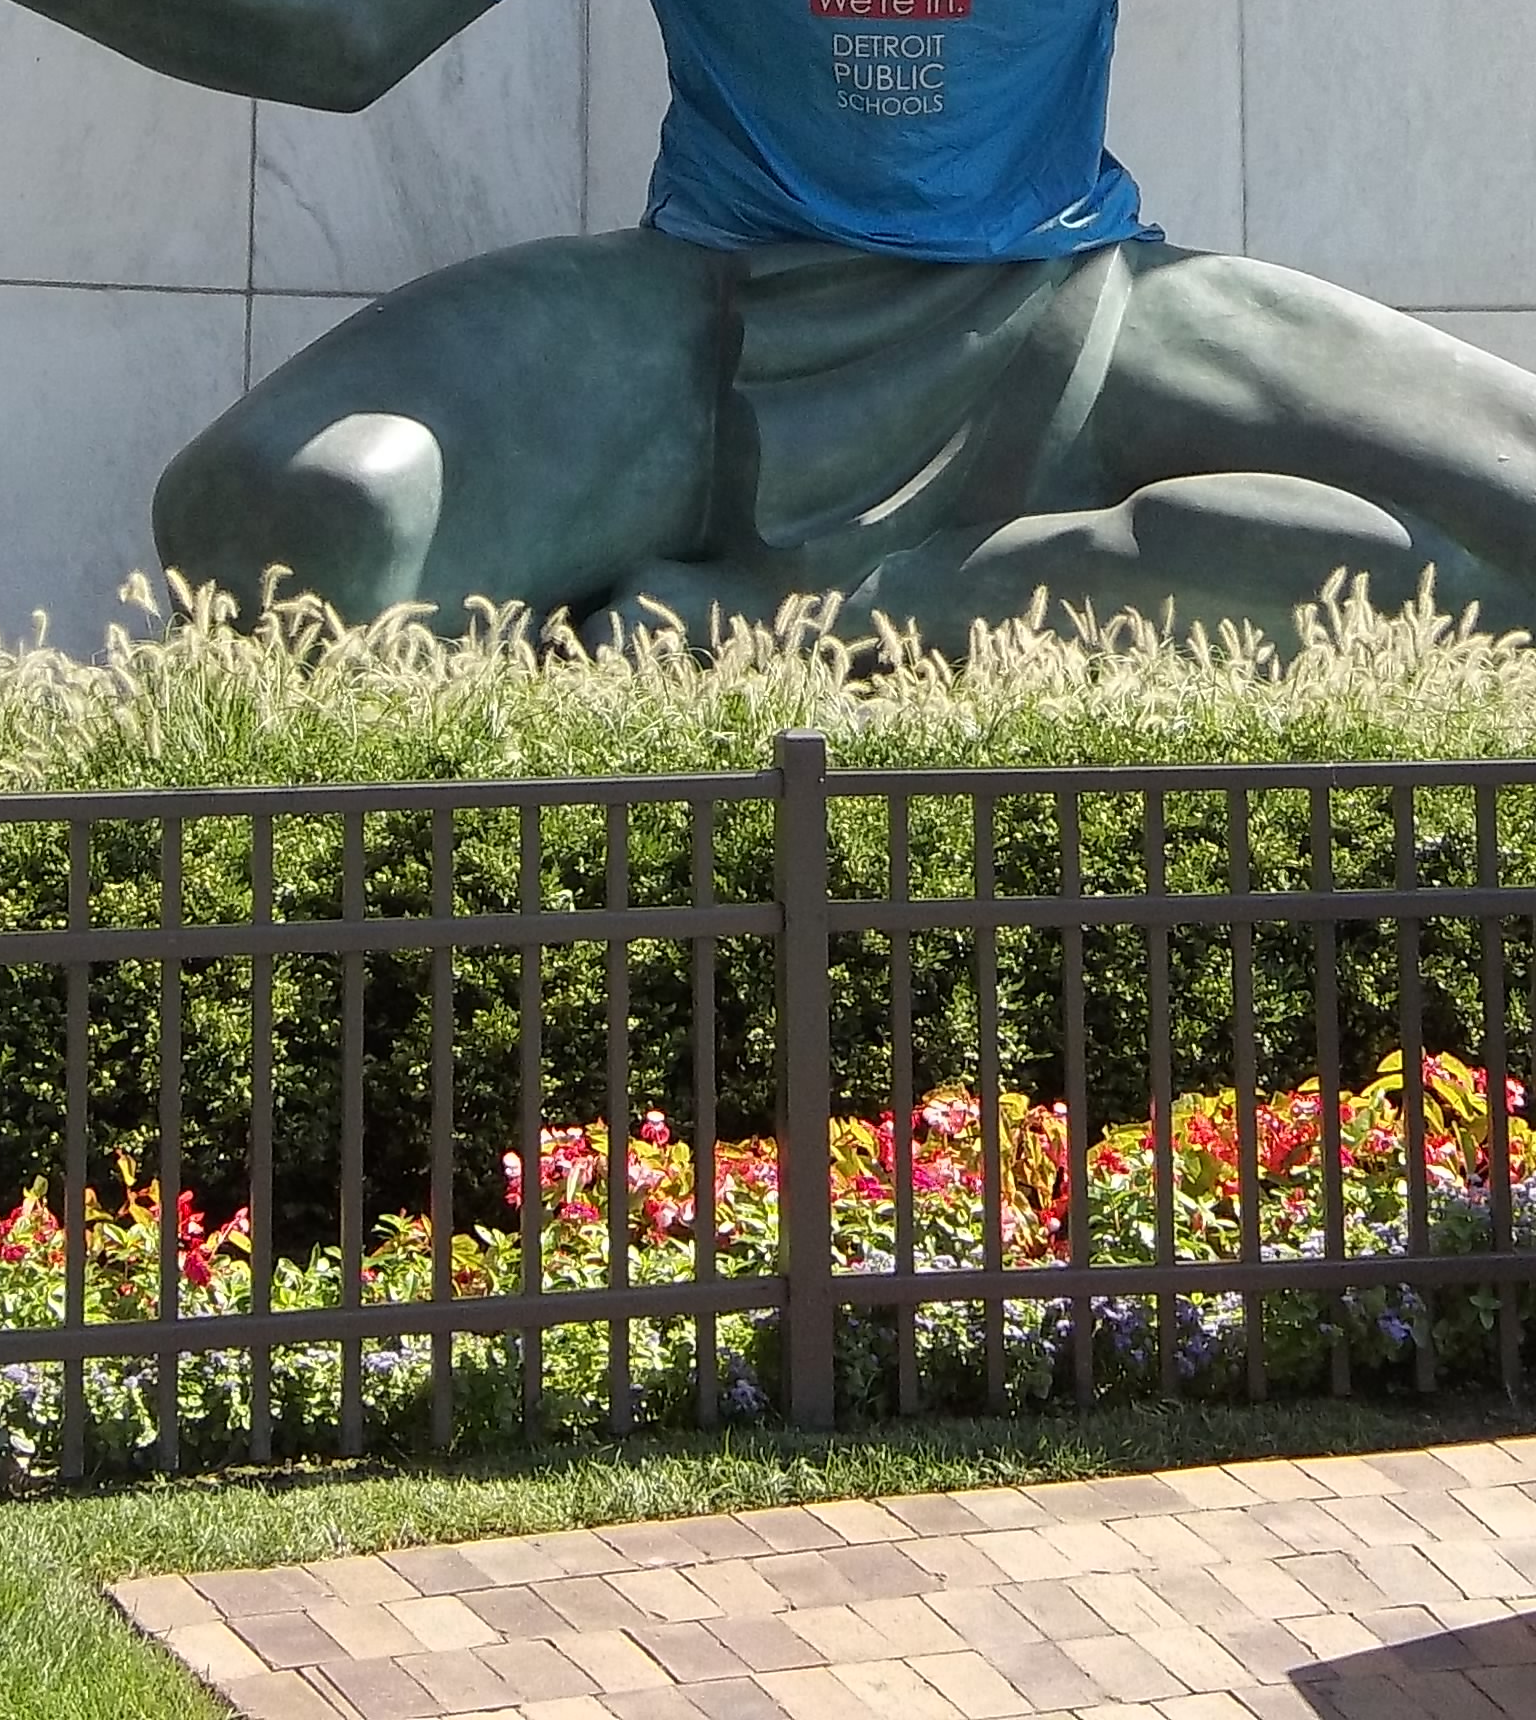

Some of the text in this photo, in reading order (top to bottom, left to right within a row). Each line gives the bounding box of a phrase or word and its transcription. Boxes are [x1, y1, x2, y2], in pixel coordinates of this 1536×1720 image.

[832, 32, 946, 60] DETROIT
[833, 62, 946, 92] PUBLIC
[837, 89, 945, 117] SCHOOLS
